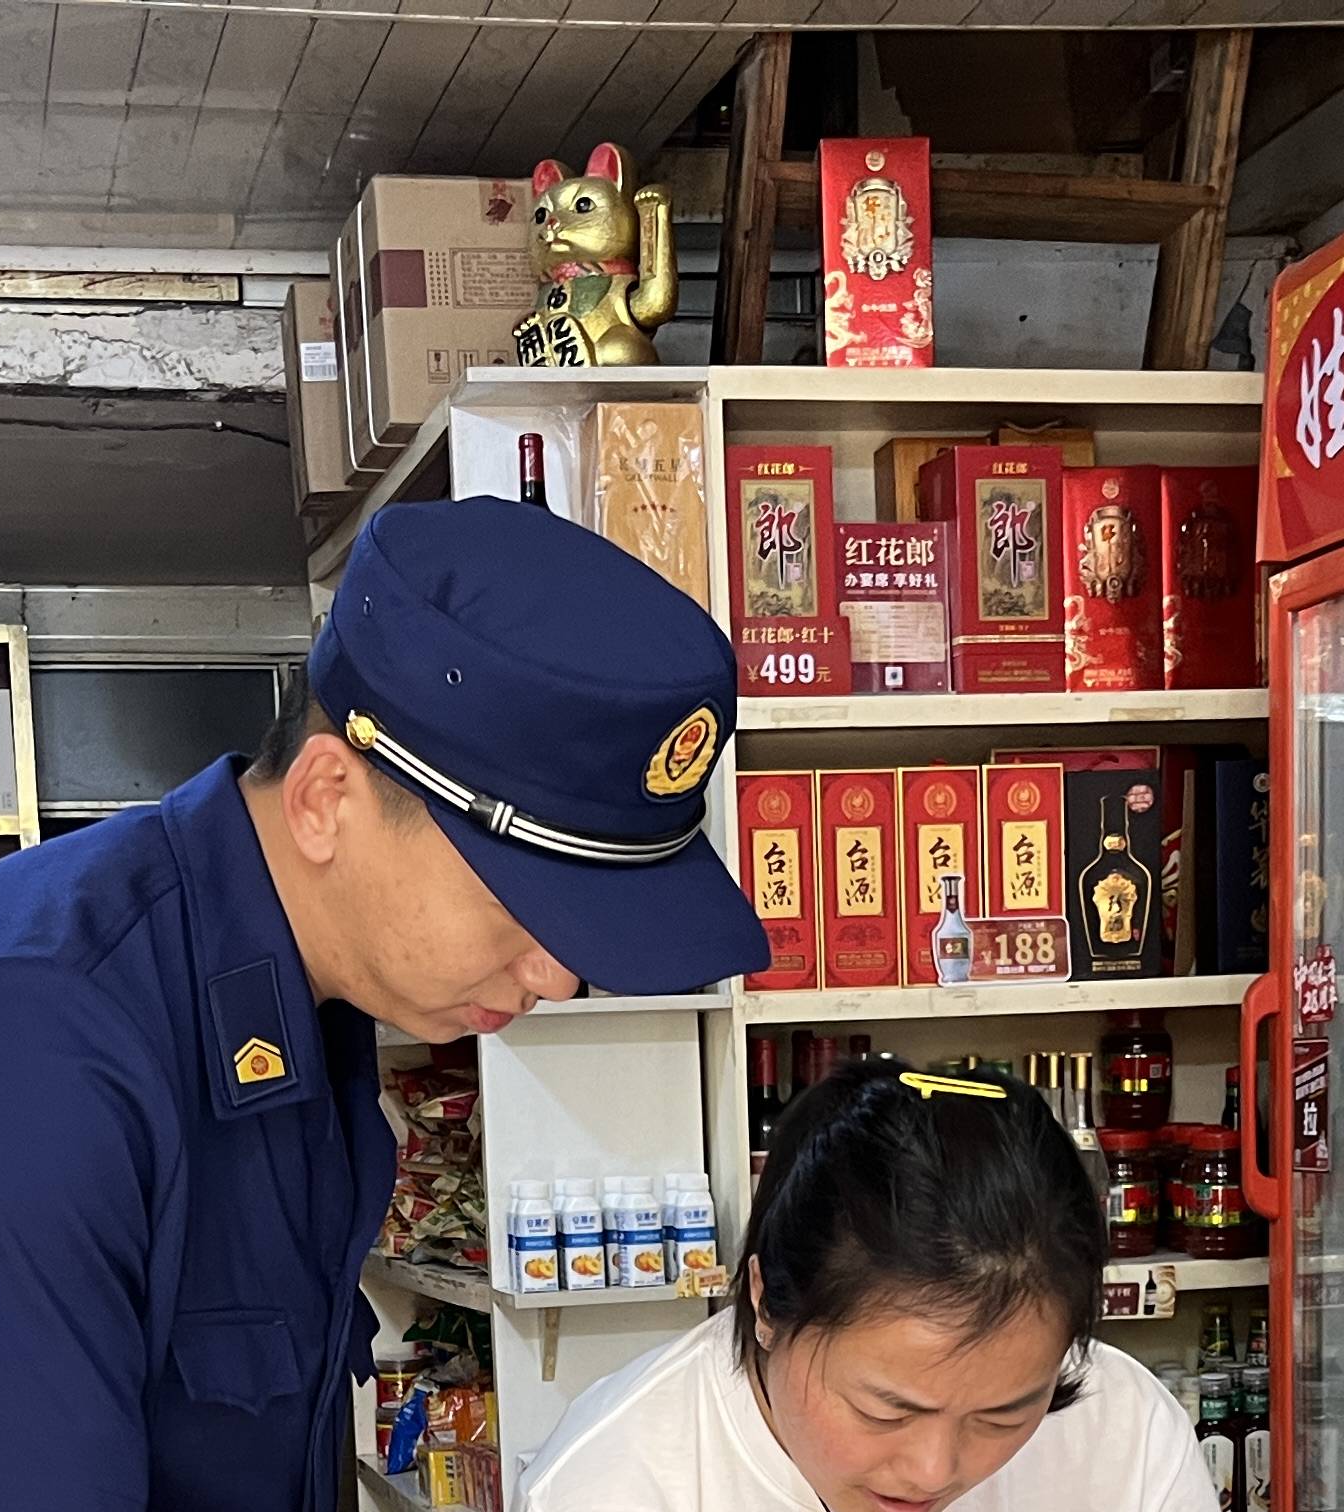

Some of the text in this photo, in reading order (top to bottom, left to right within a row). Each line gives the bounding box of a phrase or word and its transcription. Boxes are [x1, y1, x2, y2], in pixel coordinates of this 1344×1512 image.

[755, 503, 803, 590] 郎
[844, 536, 935, 567] 红花郎
[988, 501, 1036, 588] 郎
[762, 842, 792, 910] 台源
[845, 840, 874, 906] 台源
[1011, 833, 1044, 900] 台源
